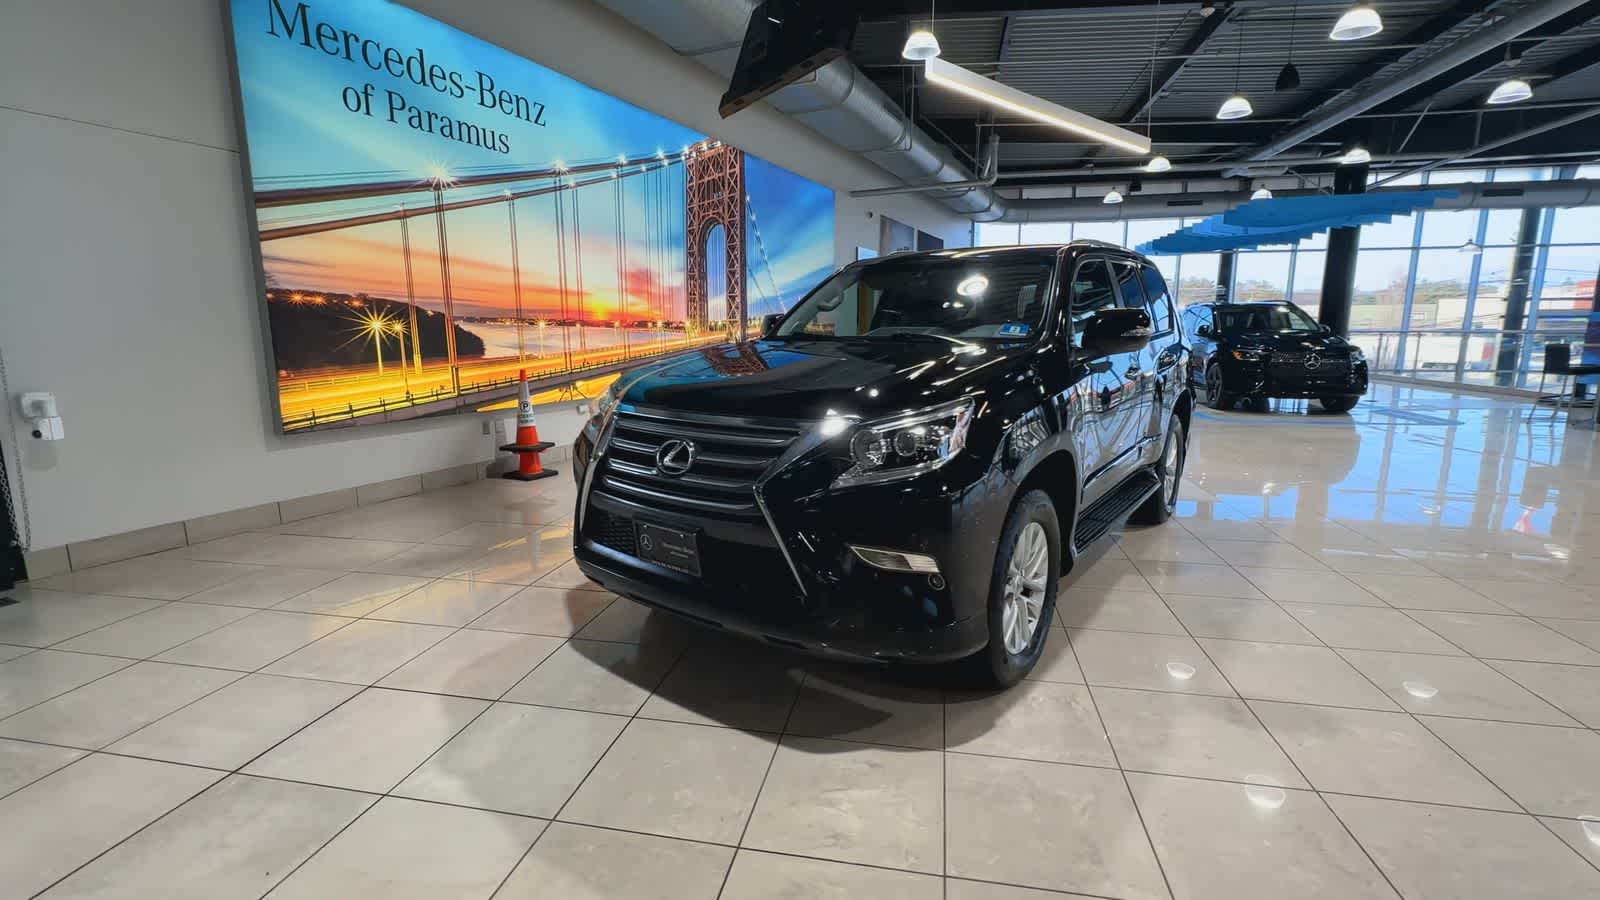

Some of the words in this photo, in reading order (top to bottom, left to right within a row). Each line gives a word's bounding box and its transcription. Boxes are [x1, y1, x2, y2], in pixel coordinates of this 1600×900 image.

[266, 0, 547, 127] Mercedes-Benz
[342, 83, 375, 117] of
[384, 89, 510, 155] Paramus
